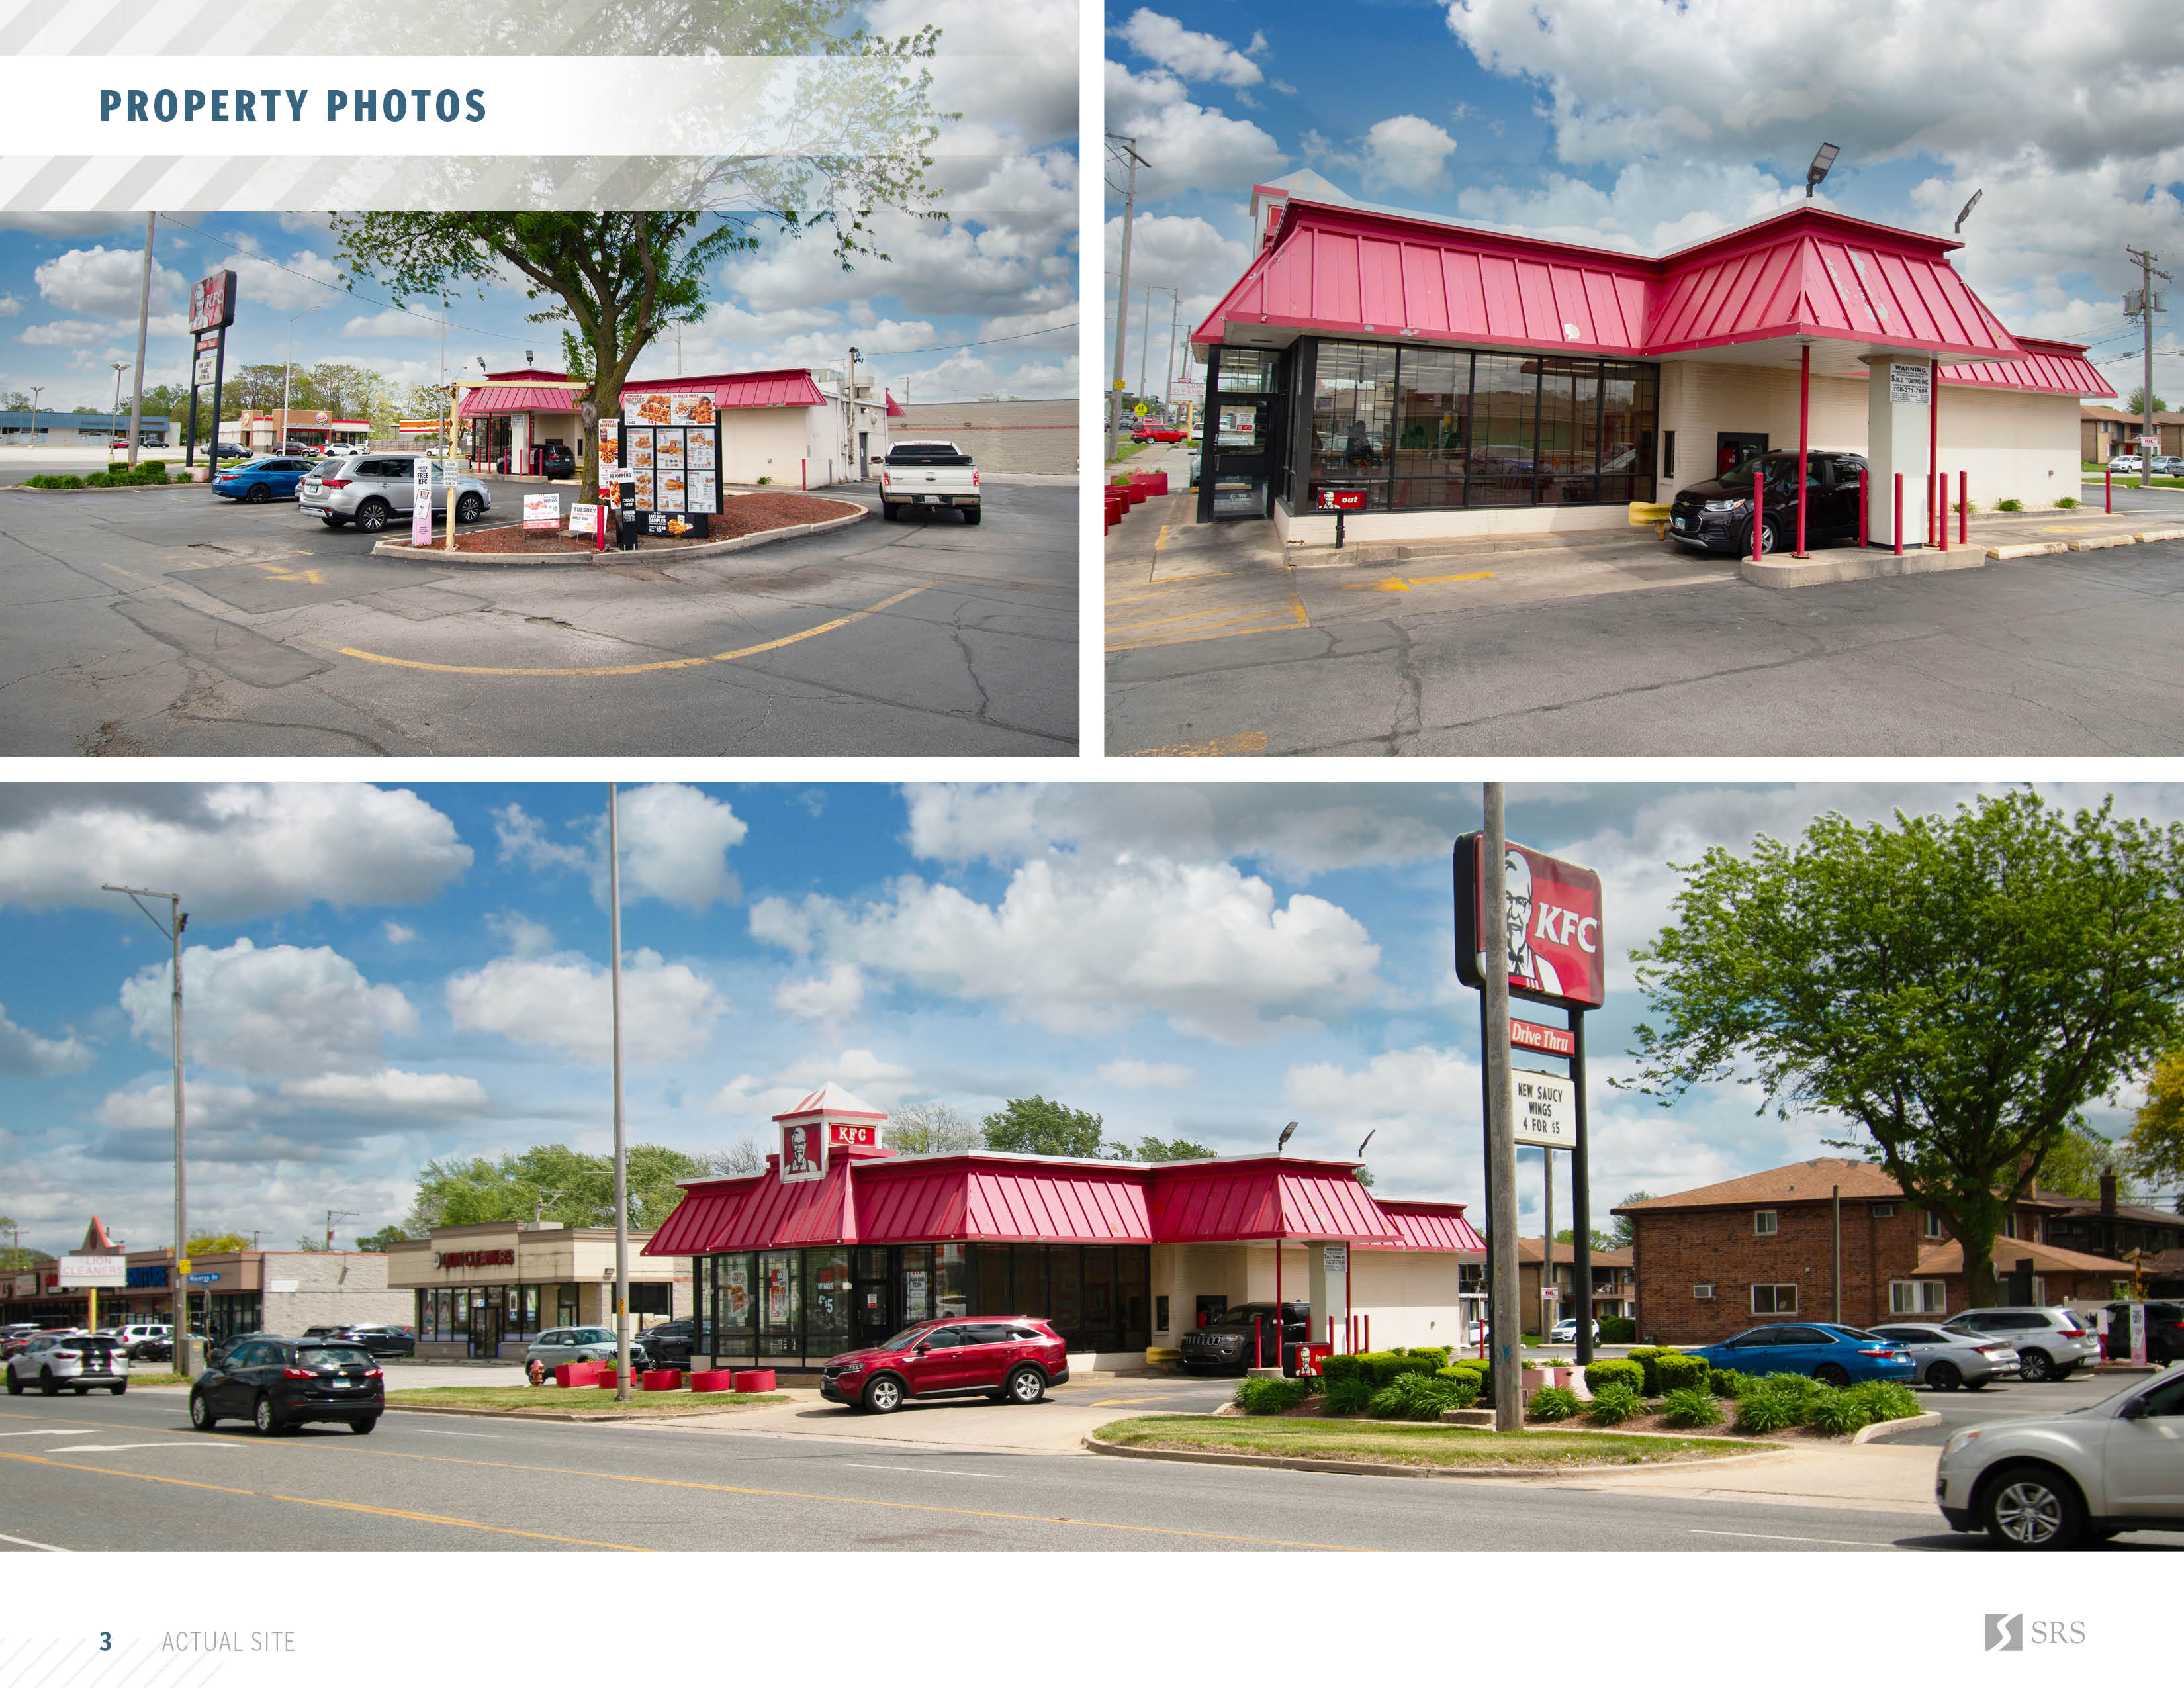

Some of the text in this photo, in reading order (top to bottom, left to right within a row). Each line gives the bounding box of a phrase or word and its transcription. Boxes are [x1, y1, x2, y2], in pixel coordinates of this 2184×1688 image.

[206, 291, 222, 309] KFC
[1534, 901, 1598, 954] KFC
[1512, 1023, 1569, 1051] Drive Thru
[1518, 1082, 1563, 1102] NEW SAUCY
[1529, 1101, 1552, 1117] WINGS
[839, 1127, 866, 1144] KFC
[1523, 1120, 1560, 1134] 4 FOR $5
[464, 1249, 515, 1267] CLEANERS
[63, 1266, 124, 1275] CLEANERS
